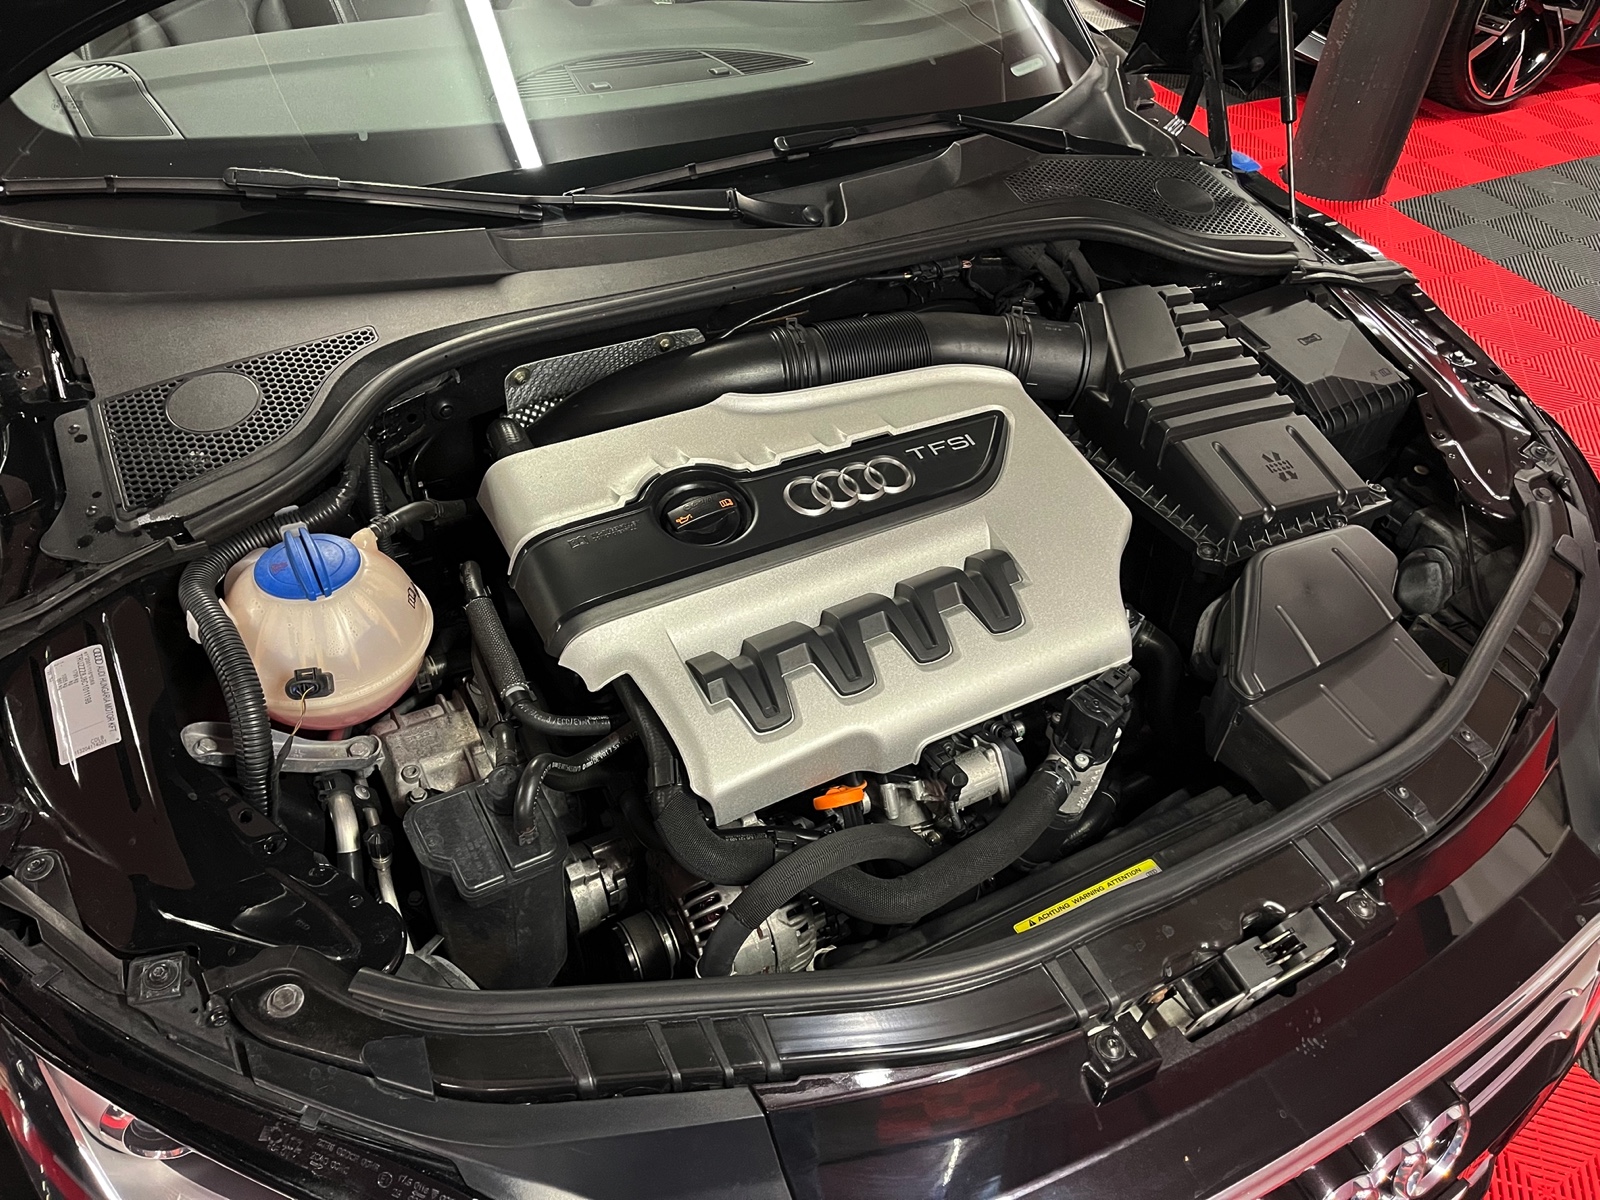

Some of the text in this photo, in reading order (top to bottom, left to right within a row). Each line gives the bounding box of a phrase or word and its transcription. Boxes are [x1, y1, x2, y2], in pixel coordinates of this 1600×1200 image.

[905, 434, 976, 459] TFSI
[1037, 867, 1142, 922] ACHTUNG WARNING ATTENTION
